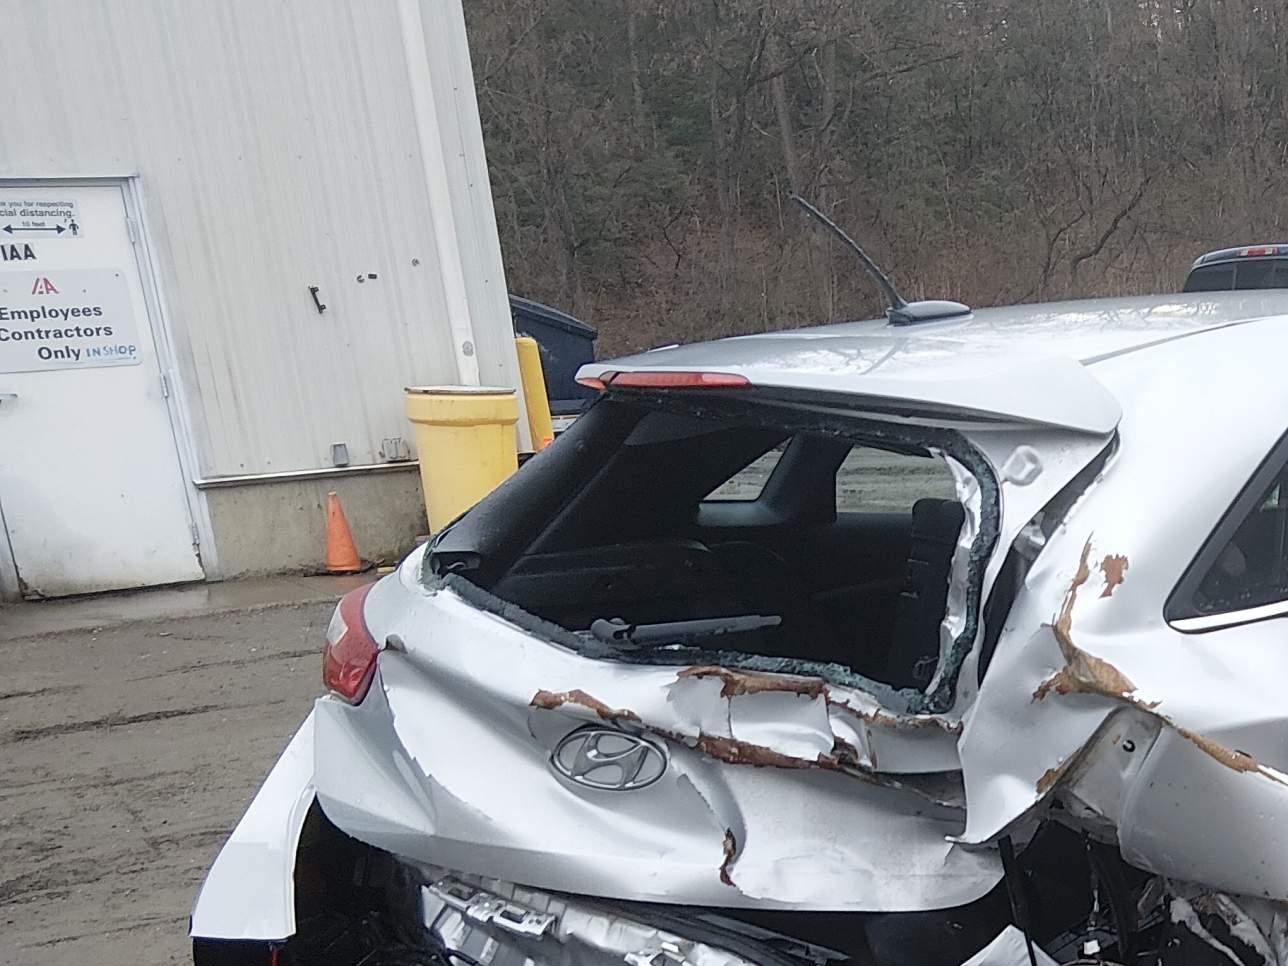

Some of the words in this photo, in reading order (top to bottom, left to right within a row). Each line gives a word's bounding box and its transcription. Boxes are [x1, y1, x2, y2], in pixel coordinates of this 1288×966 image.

[0, 208, 17, 217] cial
[0, 243, 37, 261] IAA
[0, 305, 103, 322] Employees
[0, 325, 113, 342] Contractors
[37, 345, 81, 361] Only
